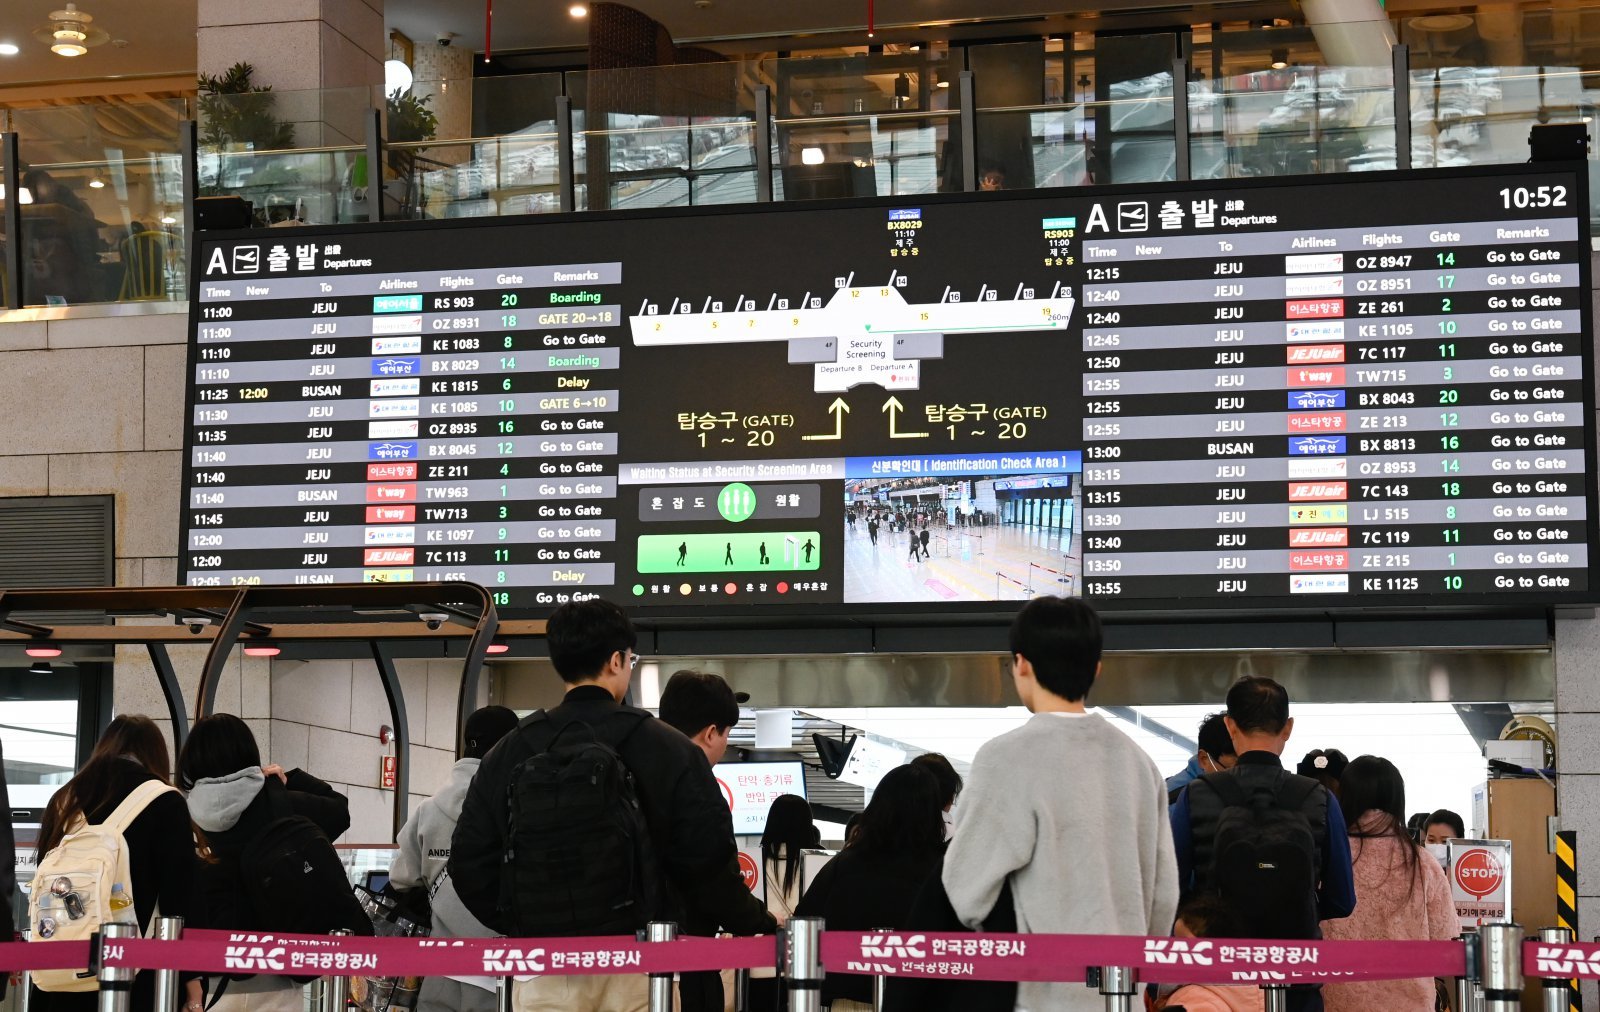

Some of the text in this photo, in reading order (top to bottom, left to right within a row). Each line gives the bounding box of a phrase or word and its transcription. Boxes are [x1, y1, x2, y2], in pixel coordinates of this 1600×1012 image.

[1500, 185, 1566, 209] 10:52
[888, 221, 922, 230] BX8029
[1085, 204, 1110, 233] A
[1221, 215, 1277, 227] Departures
[895, 230, 915, 238] 11:10
[1045, 230, 1074, 239] RS903
[1088, 226, 1549, 257] Time New To Airlines Flights Gate Remarks
[206, 247, 227, 275] A
[324, 259, 372, 270] Departures
[206, 270, 598, 297] Time New To Airlines Flights Gate Remarks
[204, 307, 232, 318] 11:00
[312, 302, 337, 313] JEJU
[434, 298, 450, 309] RS
[454, 297, 474, 308] 903
[501, 294, 517, 306] 20
[550, 291, 601, 304] Boarding
[1087, 295, 1562, 324] 12:40 JEJU 이스타항공 ZE 261 2 Go to Gate
[850, 340, 882, 349] Security
[846, 351, 886, 359] Screening
[820, 365, 855, 373] Departure
[870, 363, 906, 372] Departure
[200, 376, 589, 400] 11:25 12:00 BUSAN KE 1815 6 Delay
[678, 412, 794, 430] 탑승구 (GATE)
[926, 404, 1047, 422] 탑승구 (GATE)
[698, 432, 705, 448] 1
[747, 430, 774, 446] 20
[947, 425, 954, 440] 1
[998, 423, 1026, 439] 20
[1087, 434, 1565, 458] 13:00 BUSAN 에어부산 BX 8813 16 Go to Gate
[631, 463, 833, 480] Waiting Status at Security Screening Area
[931, 459, 998, 471] Identification
[1000, 457, 1032, 469] Check
[1035, 456, 1059, 468] Area
[195, 483, 602, 504] 11:40 BUSAN t'way TW963 1 Go to Gate
[1087, 481, 1567, 503] 13:15 JEJU JEJUair 7C 143 18 Go to Gate
[1462, 868, 1497, 878] STOP
[860, 935, 1026, 958] KAC 한국공항공사
[1144, 940, 1319, 965] KAC 한국공항공사
[224, 946, 377, 970] KAC 한국공항공사
[482, 948, 641, 971] KAC 한국공항공사
